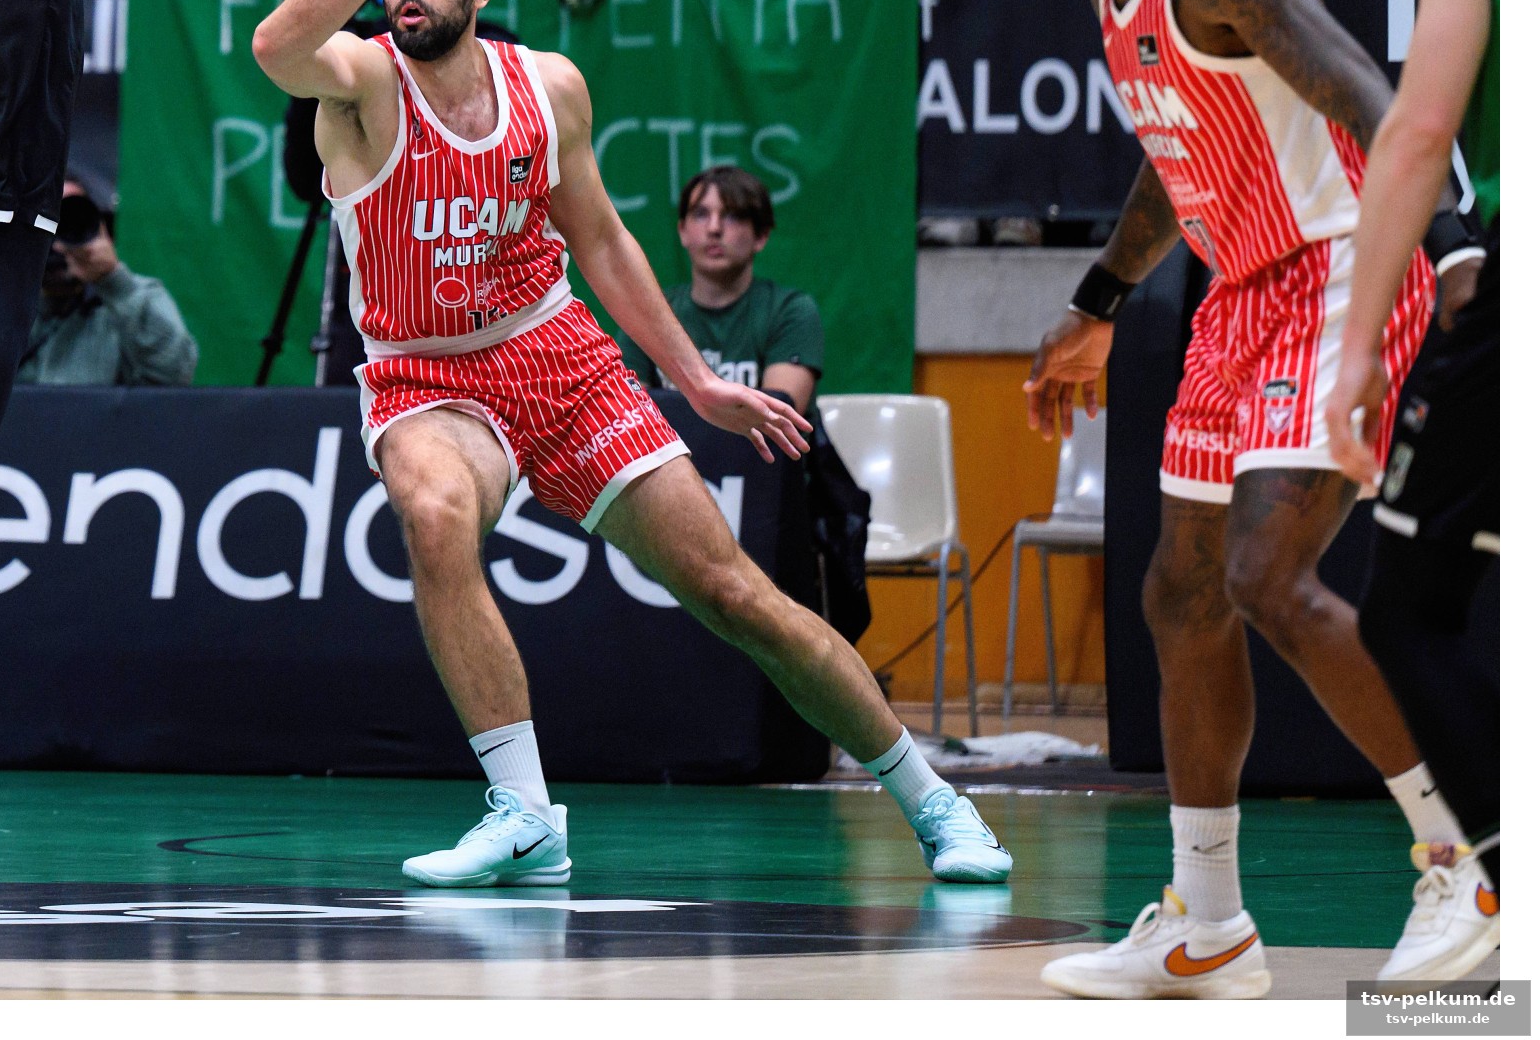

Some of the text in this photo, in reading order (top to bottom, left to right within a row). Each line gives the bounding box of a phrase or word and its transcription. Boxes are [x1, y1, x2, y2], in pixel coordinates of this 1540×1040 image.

[1116, 78, 1200, 130] CAM
[511, 165, 523, 174] liga
[412, 195, 531, 242] UCAM
[573, 407, 644, 467] INVERSUS
